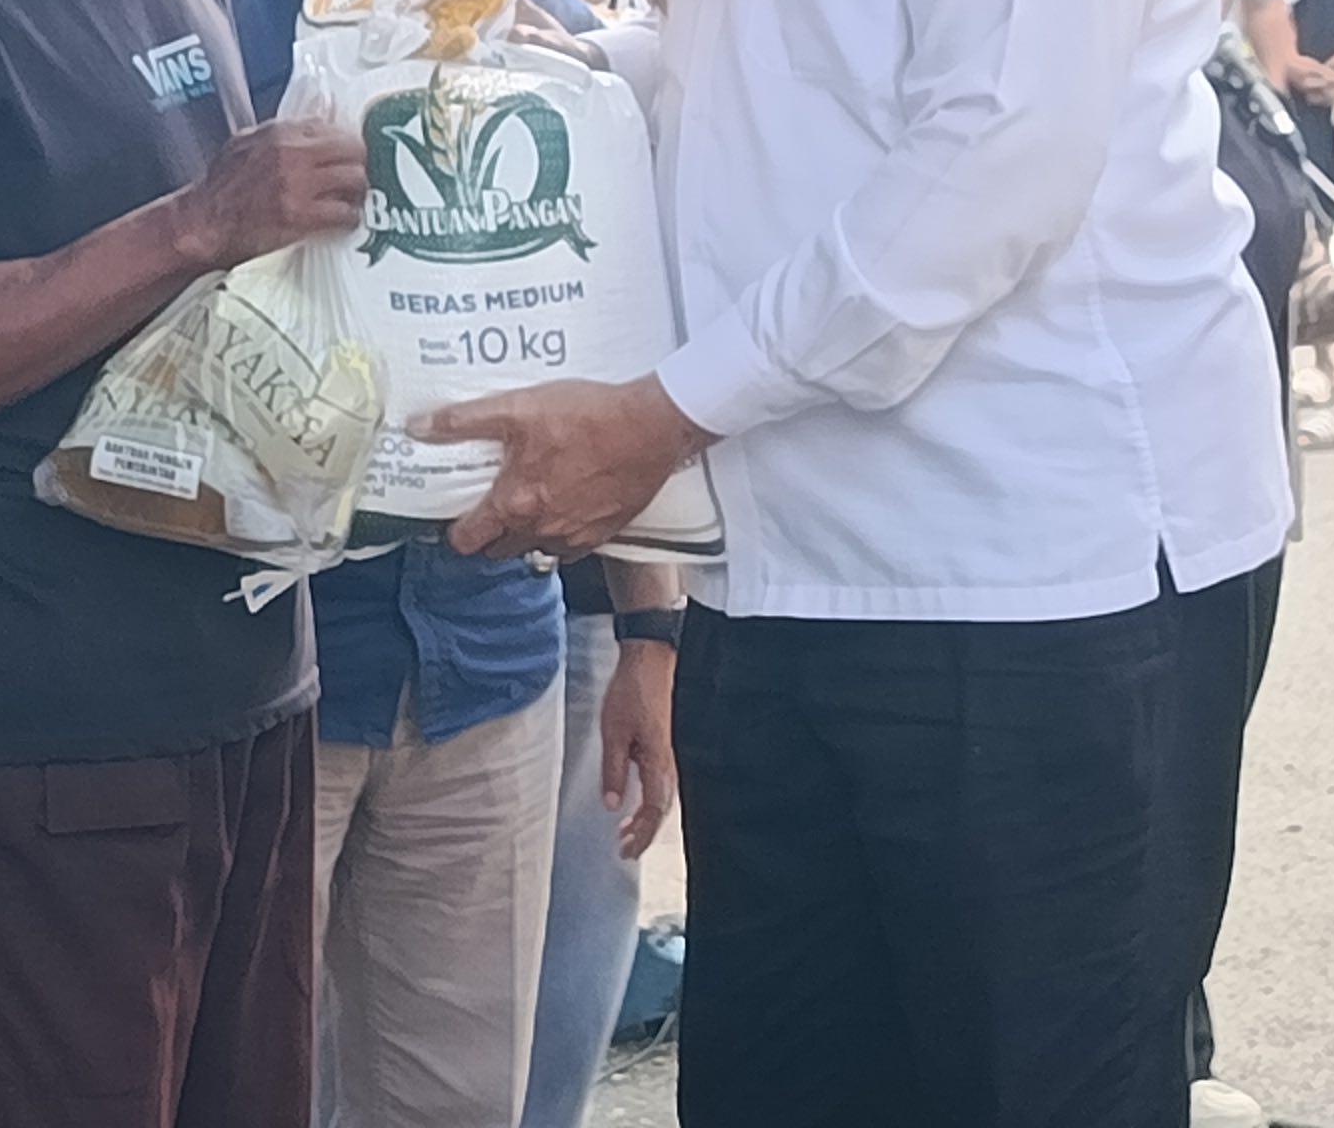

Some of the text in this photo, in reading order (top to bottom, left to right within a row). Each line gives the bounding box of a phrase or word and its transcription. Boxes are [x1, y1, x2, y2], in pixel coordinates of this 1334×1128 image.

[364, 187, 584, 236] BANTUAN PANGAN
[389, 280, 585, 315] BERAS MEDIUM
[458, 324, 567, 367] 10 kg
[374, 437, 415, 457] LOG
